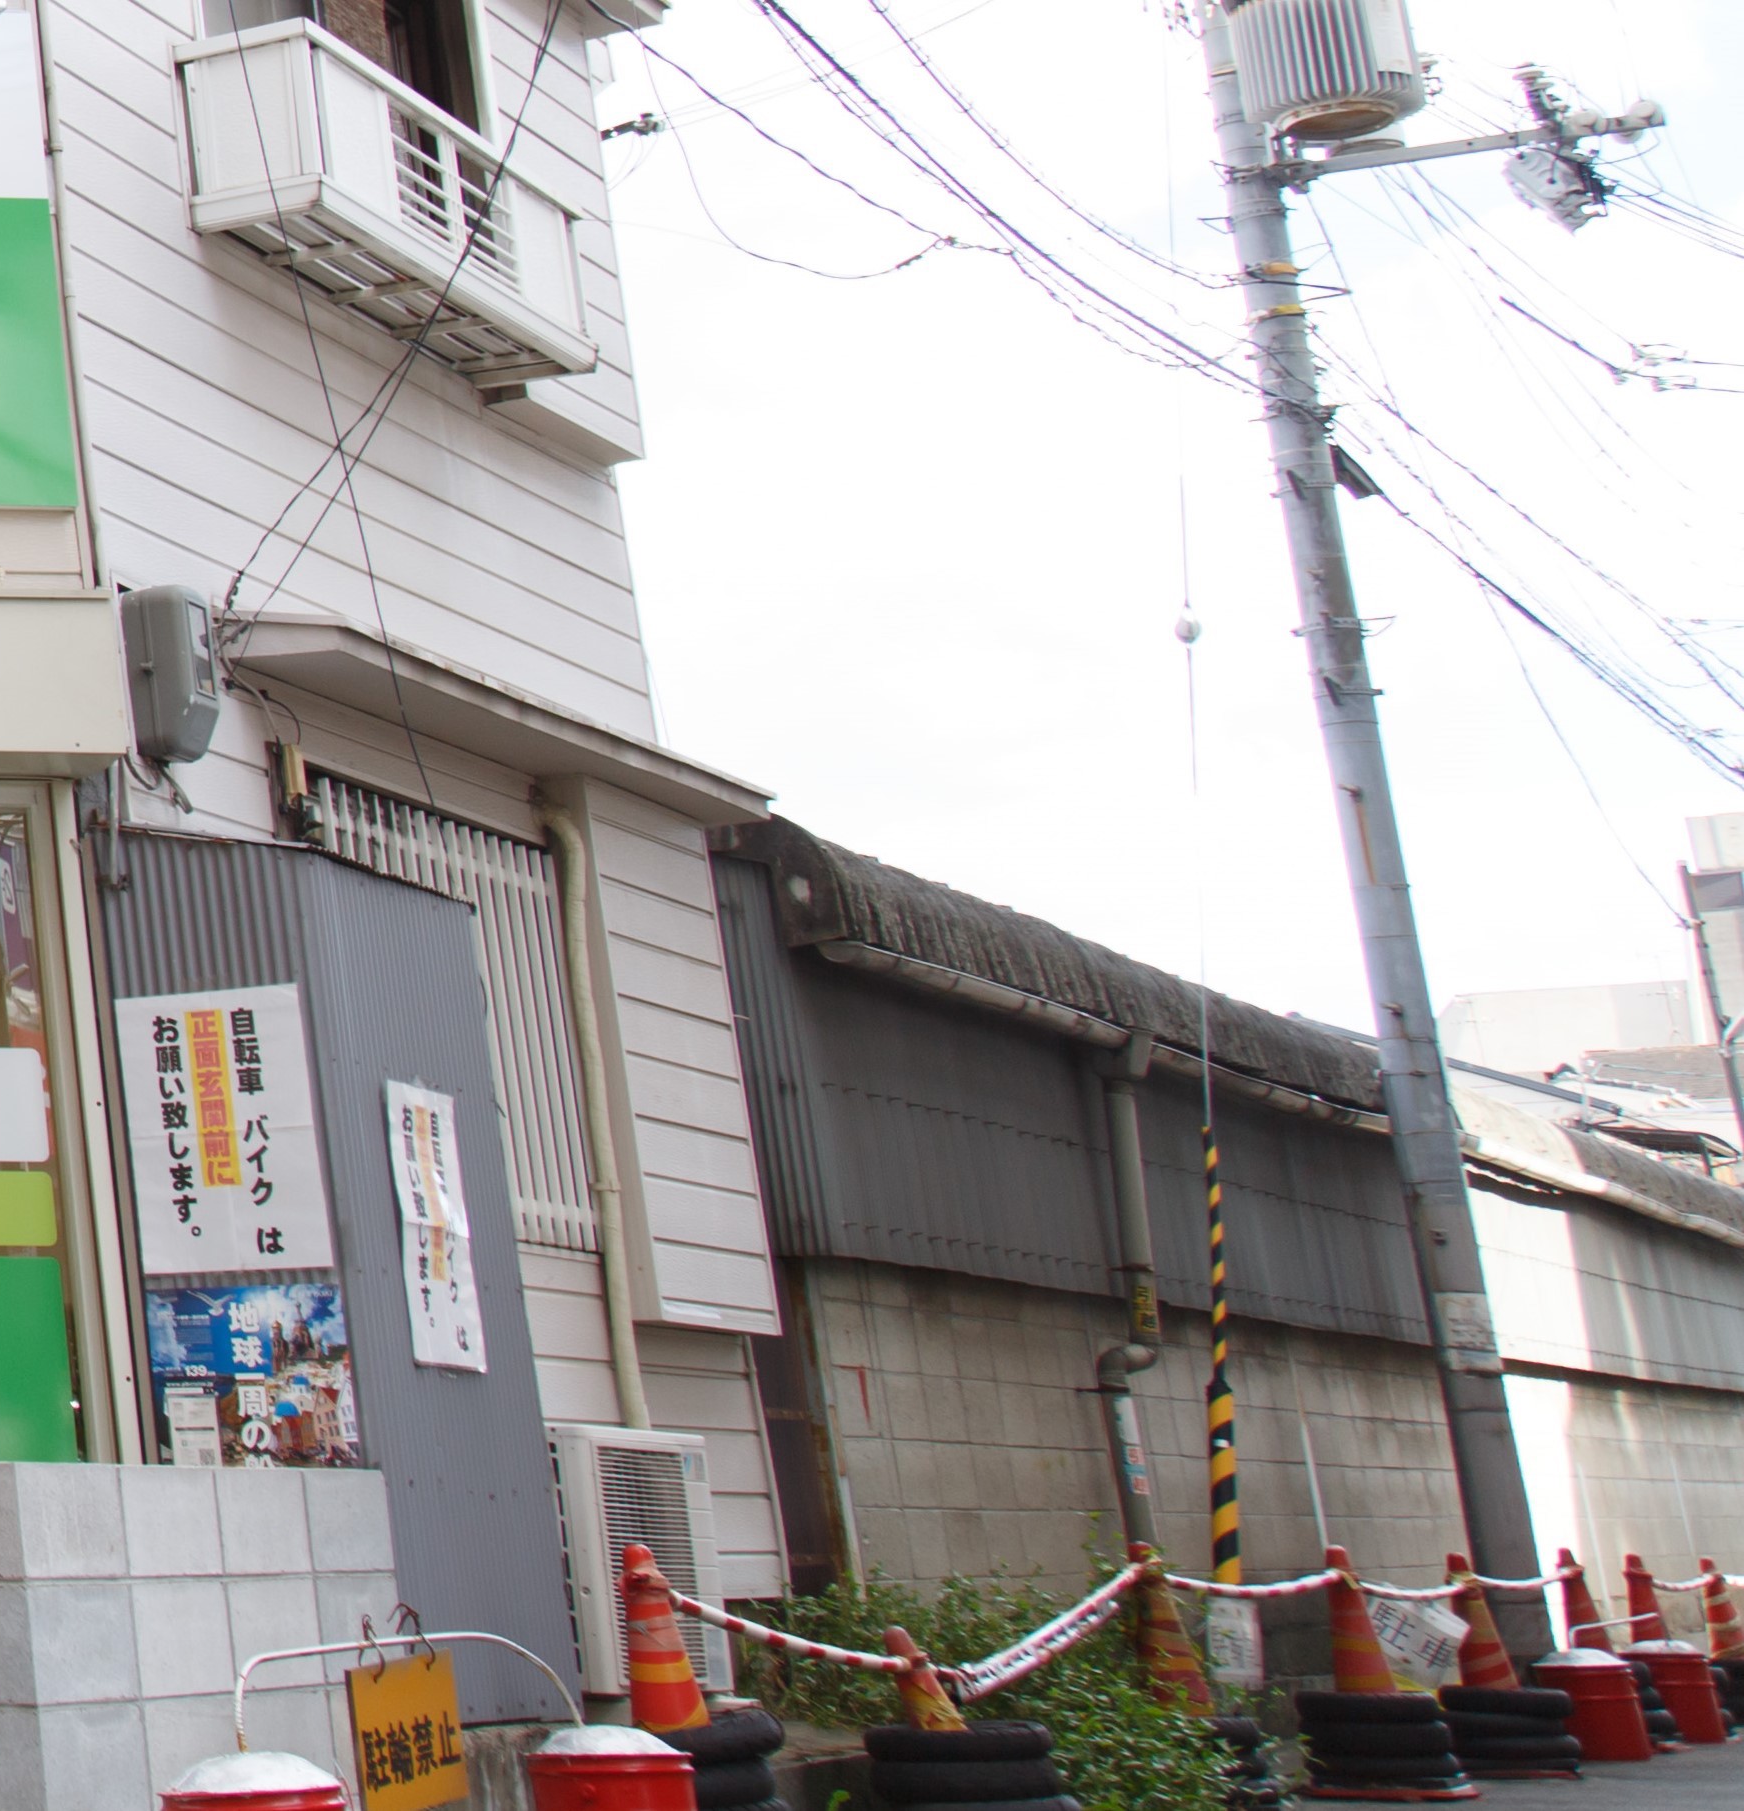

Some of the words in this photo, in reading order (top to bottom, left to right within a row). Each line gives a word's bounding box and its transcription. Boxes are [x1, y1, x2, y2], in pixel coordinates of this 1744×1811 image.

[230, 1008, 265, 1096] 自転車
[152, 1015, 202, 1237] お願い致します。
[190, 1010, 236, 1186] 正面玄関前に
[243, 1114, 273, 1206] バイク
[256, 1226, 285, 1255] は
[362, 1711, 462, 1792] 駐輪禁止
